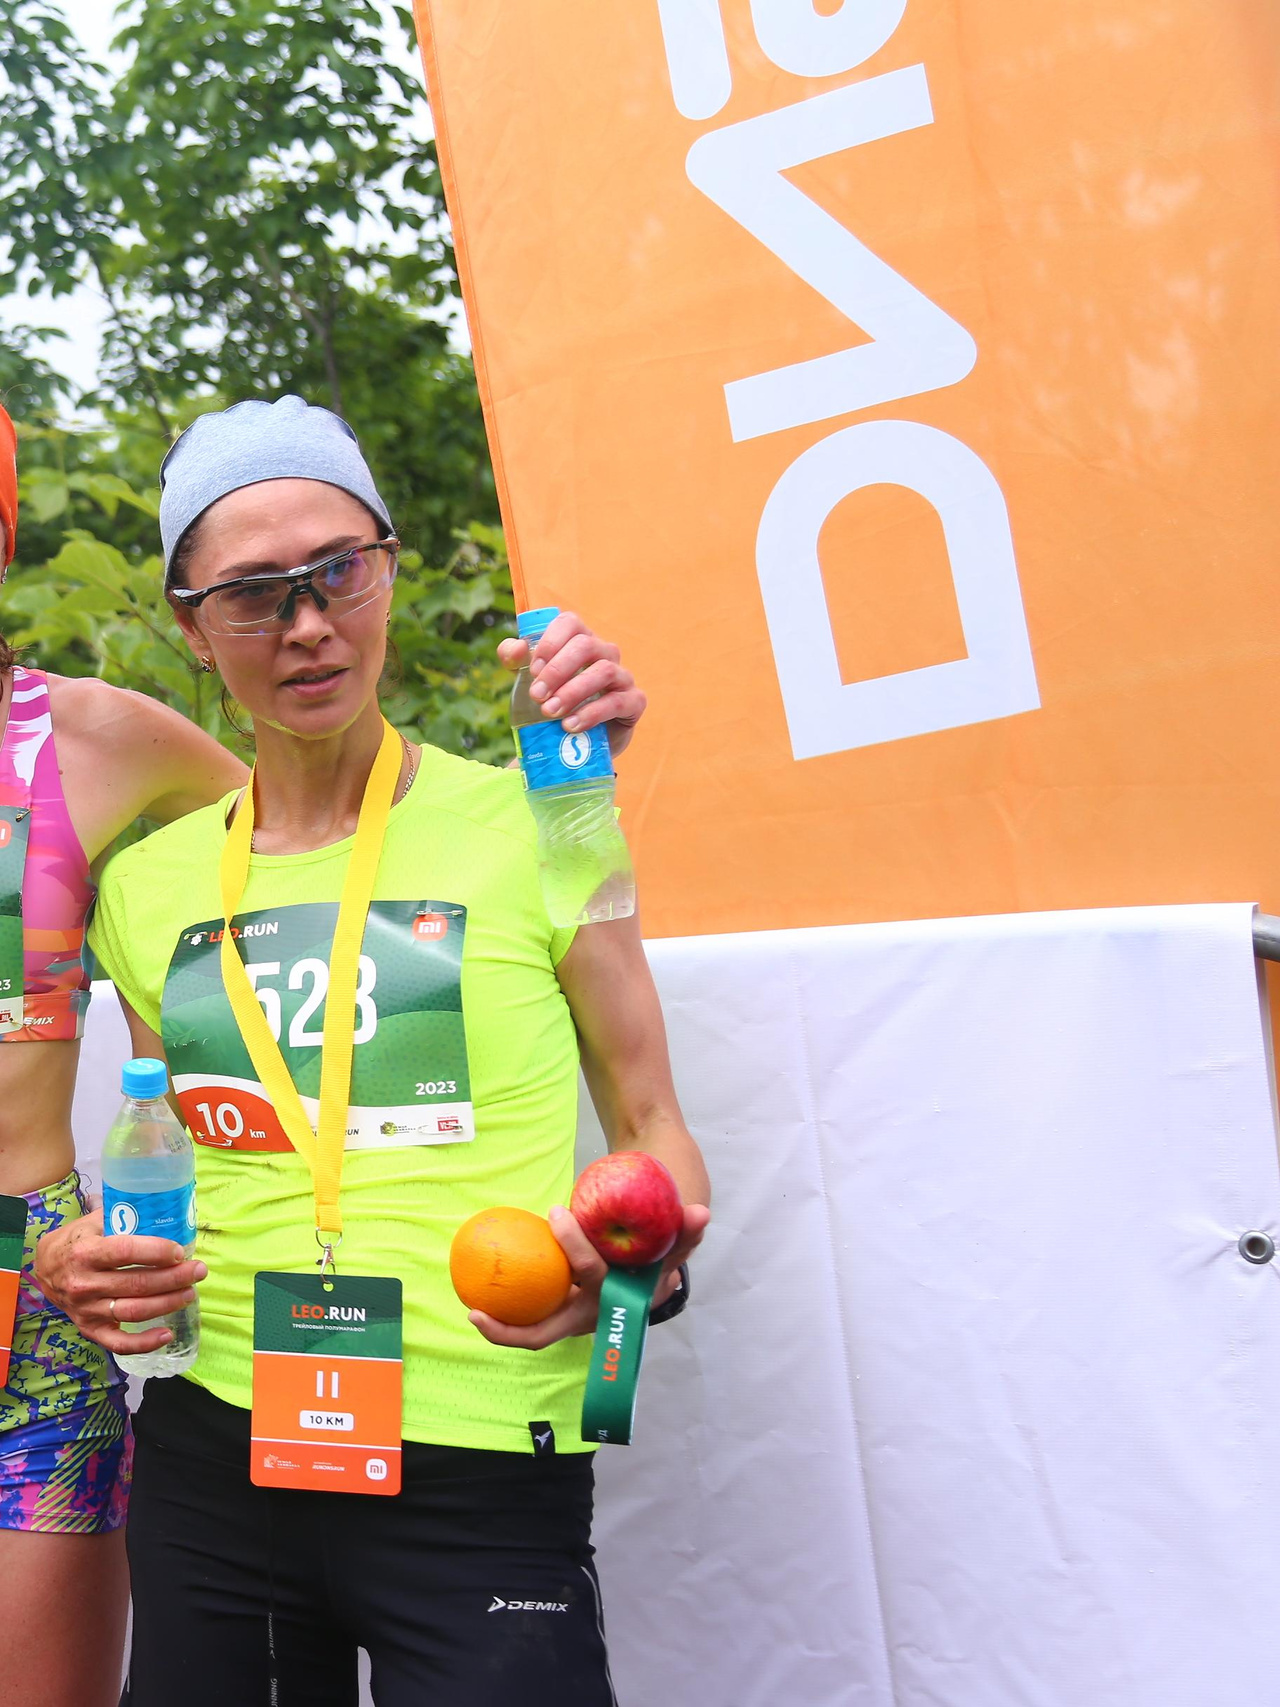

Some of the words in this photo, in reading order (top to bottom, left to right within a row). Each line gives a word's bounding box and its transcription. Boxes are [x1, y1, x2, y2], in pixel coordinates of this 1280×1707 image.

[415, 1080, 457, 1096] 2023
[196, 1102, 245, 1139] 10
[249, 1127, 267, 1140] km
[291, 1304, 367, 1322] LEO.RUN
[325, 1325, 366, 1333] ПОЛУМАРАФОН
[602, 1306, 627, 1382] LEO.RUN
[316, 1370, 339, 1399] II
[309, 1415, 323, 1425] 10
[325, 1416, 344, 1426] KM
[507, 1600, 569, 1612] DEMIX
